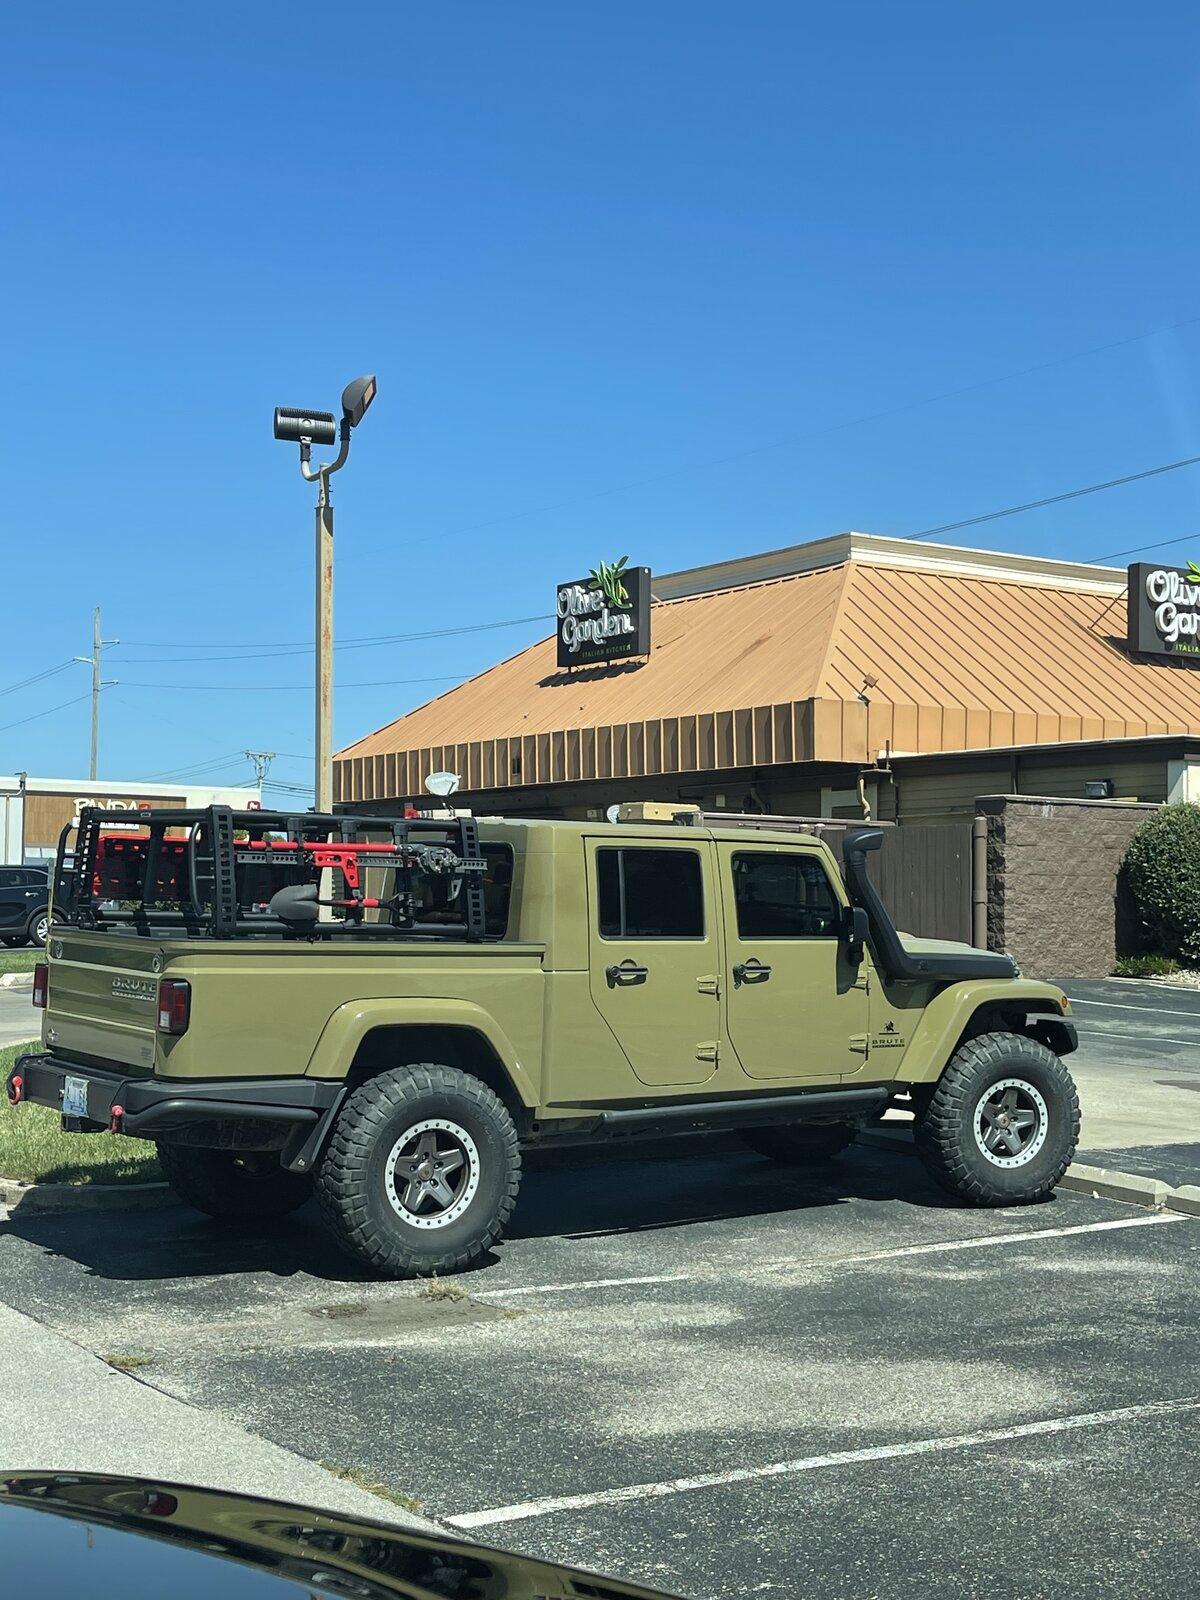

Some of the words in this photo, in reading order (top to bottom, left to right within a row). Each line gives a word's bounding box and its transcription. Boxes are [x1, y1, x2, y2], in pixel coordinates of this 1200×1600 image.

[557, 585, 605, 618] Olive
[1146, 570, 1200, 605] Oliv
[562, 608, 635, 653] Garden
[112, 977, 156, 992] BRUTE
